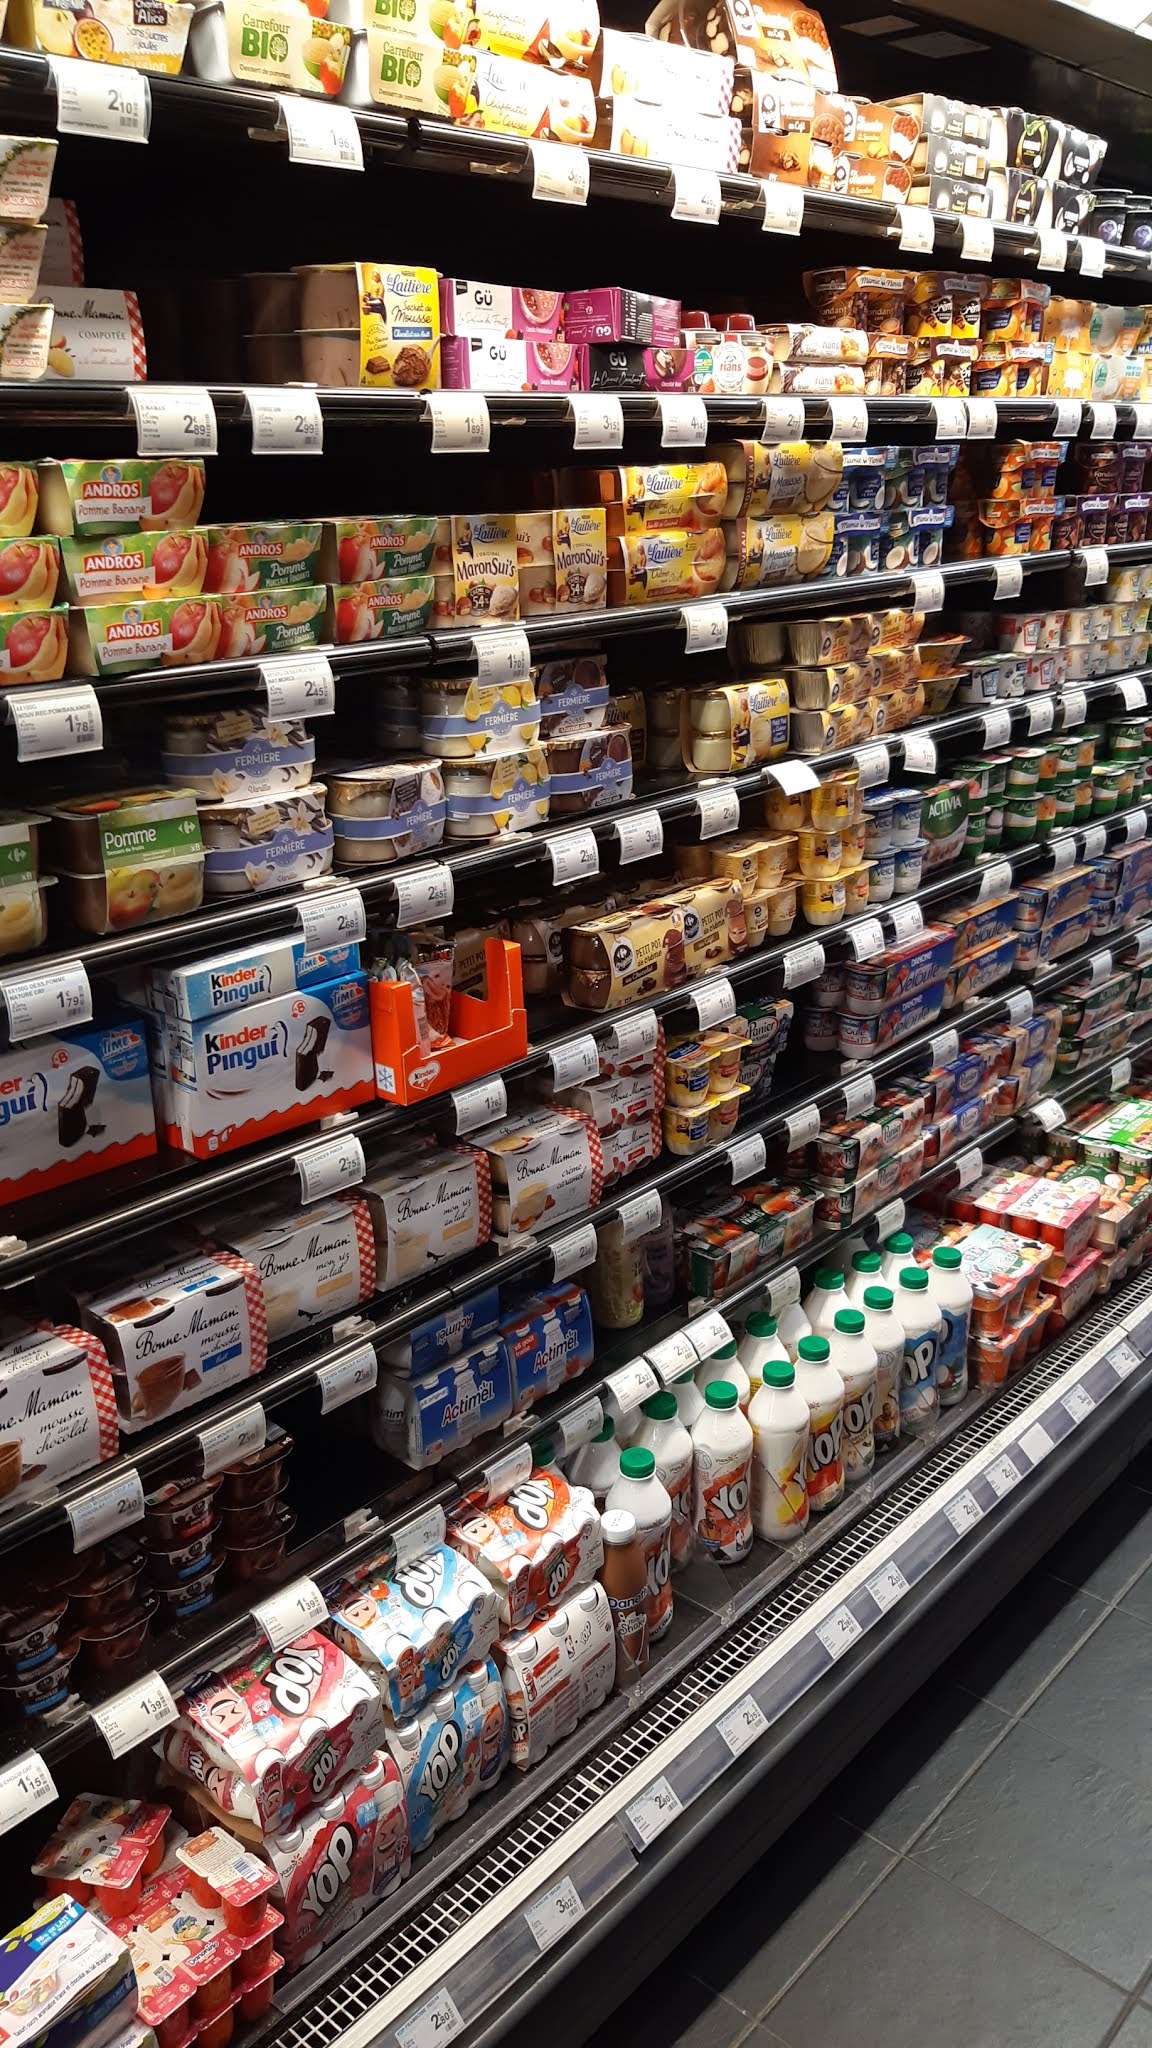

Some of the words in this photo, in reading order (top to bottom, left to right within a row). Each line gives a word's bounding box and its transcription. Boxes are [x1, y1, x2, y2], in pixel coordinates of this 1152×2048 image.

[138, 13, 166, 25] Alice
[243, 14, 290, 34] Carrefour
[241, 28, 289, 63] BIO
[383, 42, 424, 62] Carrefour
[380, 54, 422, 88] BIO
[390, 276, 432, 296] Laitière
[475, 290, 492, 306] GÜ
[403, 302, 423, 312] Secret
[392, 308, 432, 324] Mousse
[79, 330, 126, 340] COMPOTÉE
[490, 345, 506, 361] GÜ
[822, 339, 839, 350] rians
[609, 352, 627, 366] GÜ
[720, 362, 742, 373] rians
[815, 377, 833, 386] rians
[84, 483, 140, 497] ANDROS
[647, 475, 683, 492] Laitière
[79, 505, 110, 516] Pomme
[113, 504, 146, 515] Banane
[475, 524, 510, 543] Laitière
[572, 518, 601, 535] Laitière
[239, 543, 282, 555] ANDROS
[371, 535, 405, 548] ANDROS
[648, 542, 683, 559] Laitière
[86, 554, 142, 570] ANDROS
[393, 552, 423, 567] Pomme
[557, 549, 605, 570] MaronSui's
[271, 561, 306, 578] Pomme
[457, 558, 515, 581] MaronSui's
[80, 575, 112, 588] Pomme
[115, 574, 150, 585] Banane
[368, 595, 402, 606] ANDROS
[245, 607, 287, 620] ANDROS
[392, 610, 421, 625] Pomme
[107, 623, 160, 638] ANDROS
[276, 623, 310, 640] Pomme
[103, 645, 133, 657] Pomme
[135, 642, 167, 653] Banane
[558, 694, 591, 707] FERMIÈRE
[485, 712, 518, 726] FERMIÈRE
[235, 751, 281, 766] FERMIÈRE
[595, 767, 621, 782] FERMIÈRE
[508, 789, 535, 802] FERMIÈRE
[928, 794, 961, 819] ACTIVIA
[406, 811, 433, 826] FERMIÈRE
[105, 827, 157, 849] Pomme
[266, 840, 308, 858] FERMIÈRE
[701, 915, 714, 928] PETIT
[715, 908, 724, 920] POT
[636, 946, 650, 959] PETIT
[650, 938, 661, 953] POT
[911, 951, 932, 967] DANONE
[211, 967, 257, 988] Kinder
[205, 1023, 268, 1053] Kinder
[748, 1020, 777, 1039] Panier
[414, 1067, 436, 1081] Kinder
[516, 1156, 547, 1174] Bonne
[548, 1146, 582, 1167] Maman
[397, 1197, 431, 1224] Bonne
[432, 1181, 472, 1208] Maman
[301, 1234, 350, 1262] Maman
[258, 1253, 299, 1280] Bonne
[135, 1330, 182, 1360] Bonne
[186, 1305, 239, 1339] Maman
[200, 1321, 241, 1347] mousse
[209, 1332, 241, 1353] chocolat
[534, 1329, 579, 1374] Actimel
[19, 1385, 82, 1423] Maman
[441, 1381, 495, 1428] Actimel
[39, 1407, 87, 1435] mousse
[36, 1421, 90, 1455] chocolat
[548, 1558, 572, 1598] YOP
[440, 1642, 462, 1681] YOP
[312, 1744, 341, 1792] YOP
[420, 1720, 462, 1801] YOP
[301, 1822, 357, 1918] YOP
[49, 1925, 57, 1935] DE
[55, 1914, 69, 1929] LAIT
[188, 1941, 219, 1966] Danonino
